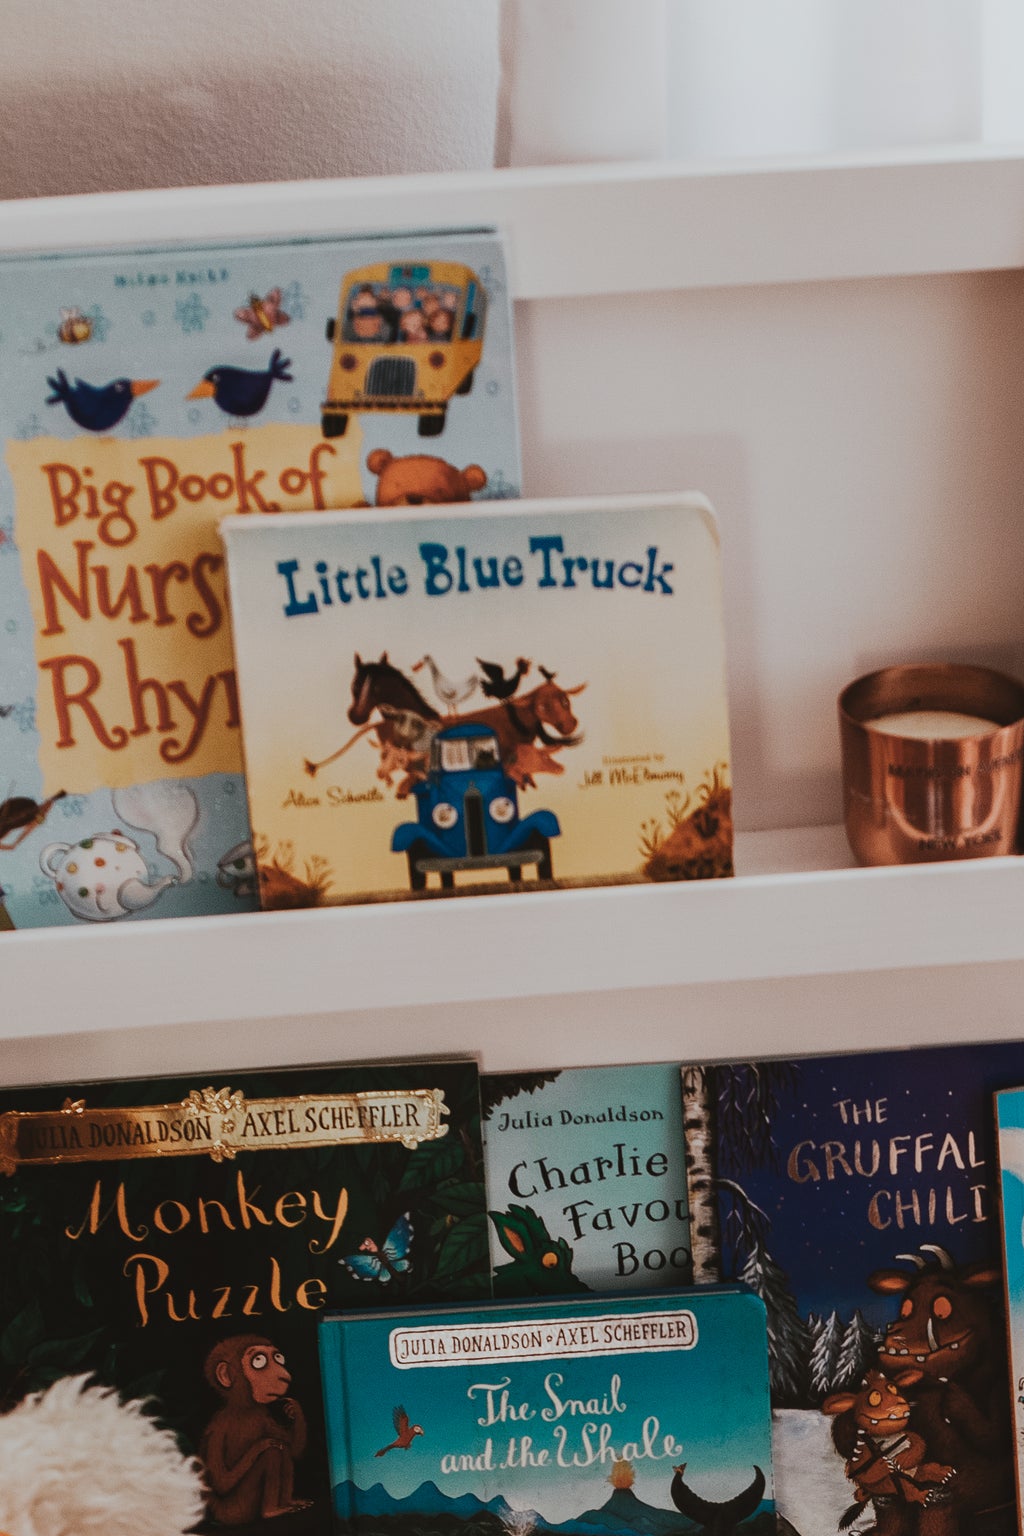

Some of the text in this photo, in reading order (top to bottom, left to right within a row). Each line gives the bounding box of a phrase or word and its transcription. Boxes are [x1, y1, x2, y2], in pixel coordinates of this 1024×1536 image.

[41, 442, 337, 547] Big Book of
[37, 541, 224, 638] Nurs
[277, 535, 674, 617] Little Blue Truck
[31, 1103, 420, 1150] ULIA DONALDSON AXEL SCHEFFLER
[497, 1105, 664, 1131] Julia Donaldson
[833, 1097, 888, 1125] THE
[507, 1143, 669, 1199] Charlie
[787, 1131, 985, 1184] GRUFFAL
[66, 1171, 349, 1254] Monkey
[123, 1253, 327, 1327] Puzzle
[400, 1321, 687, 1359] JULIA DONALDSON AXEL SCHEFFLER
[467, 1373, 627, 1427] The Snail
[440, 1416, 683, 1474] and the Whale
